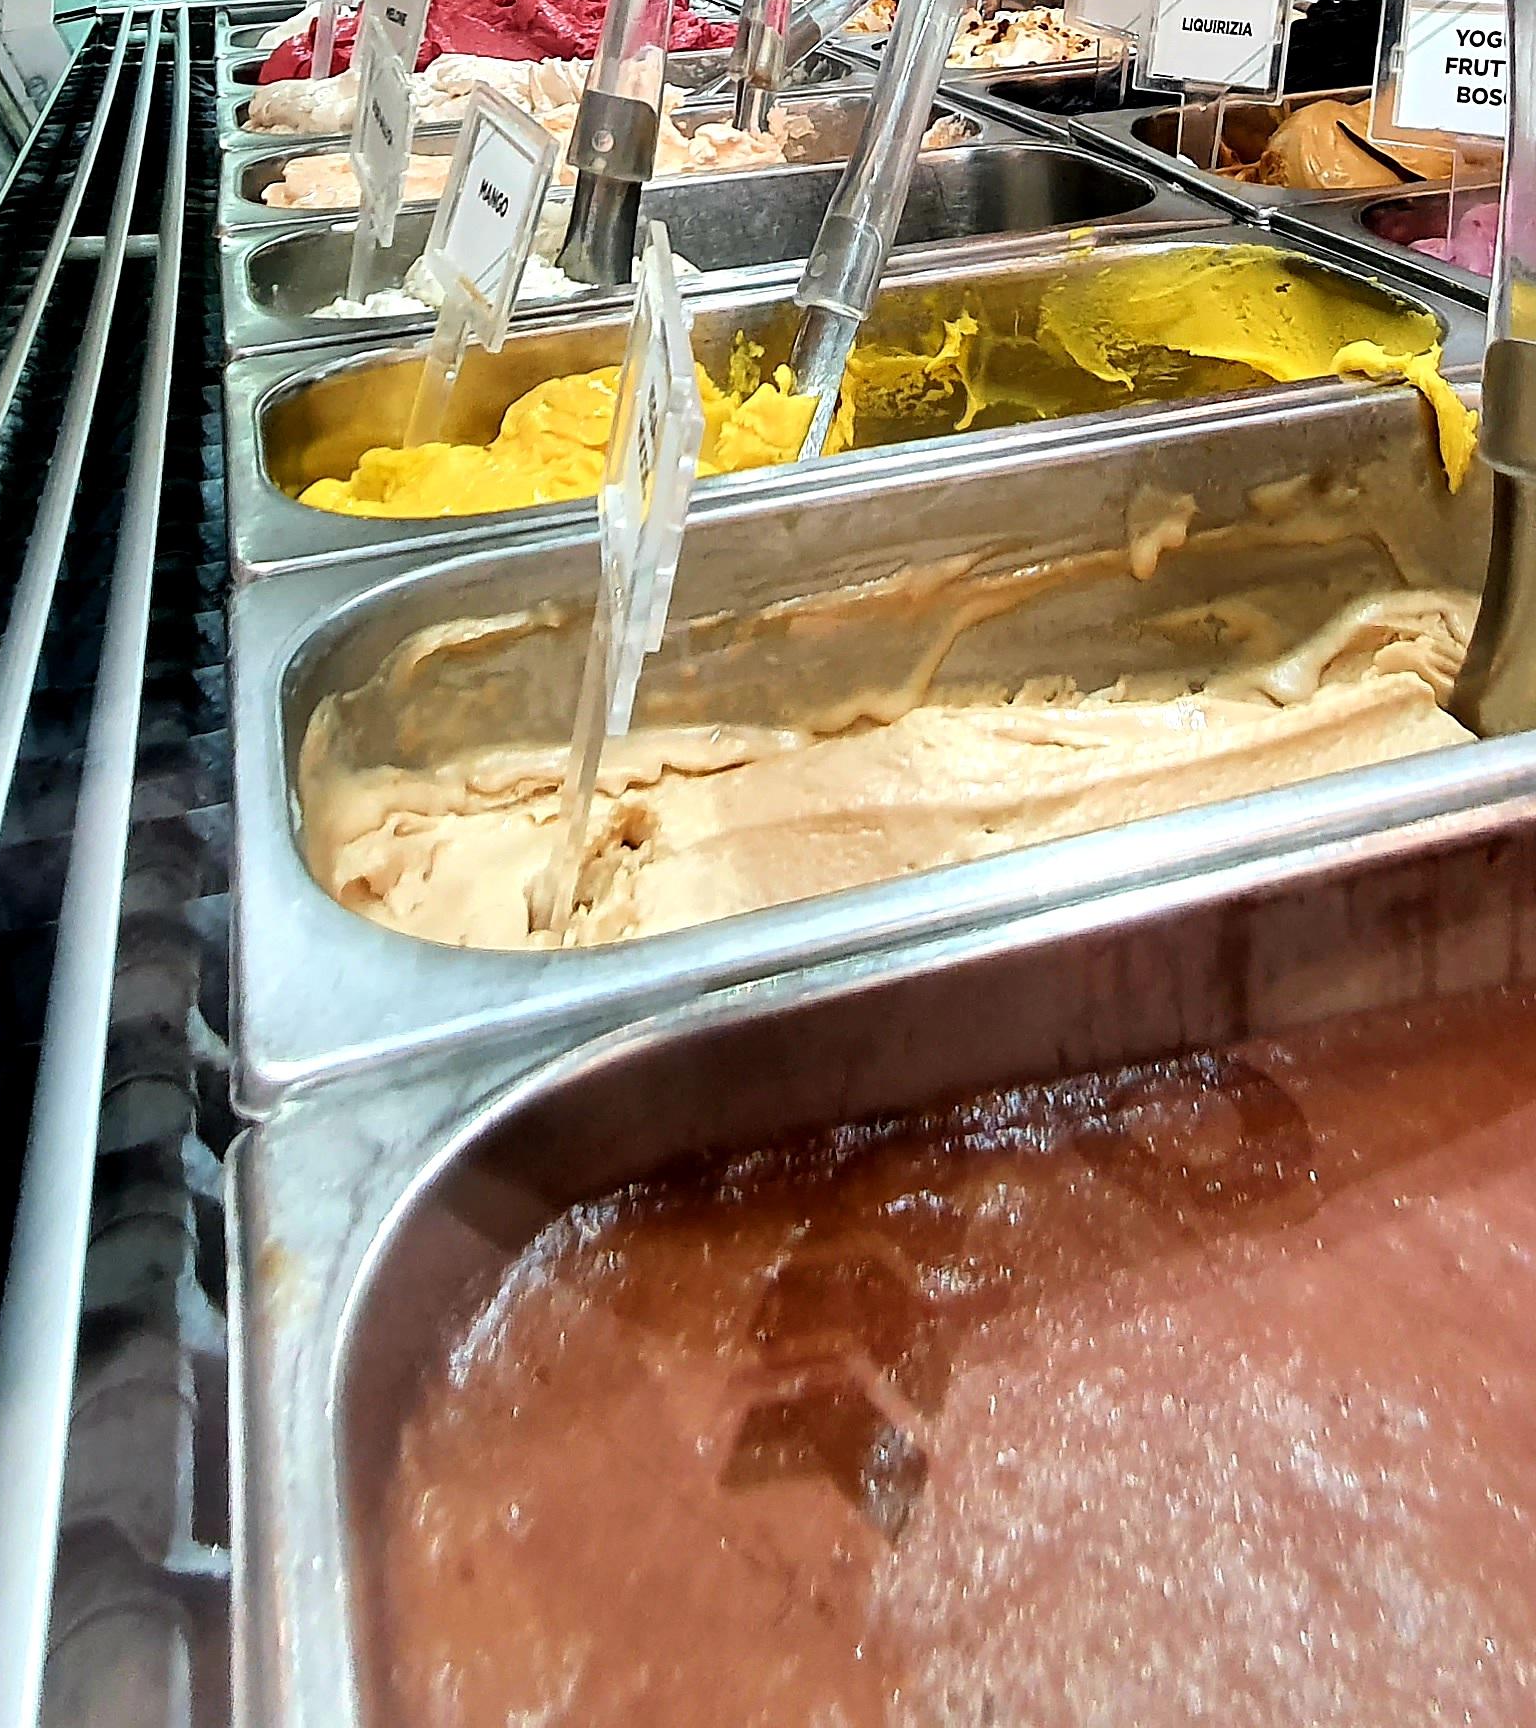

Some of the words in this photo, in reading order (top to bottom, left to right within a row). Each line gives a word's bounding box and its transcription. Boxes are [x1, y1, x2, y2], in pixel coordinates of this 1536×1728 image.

[1181, 17, 1253, 37] LIQUIRIZIA
[1455, 29, 1507, 49] YOG
[1456, 85, 1507, 107] BOS
[477, 177, 509, 219] MANGO
